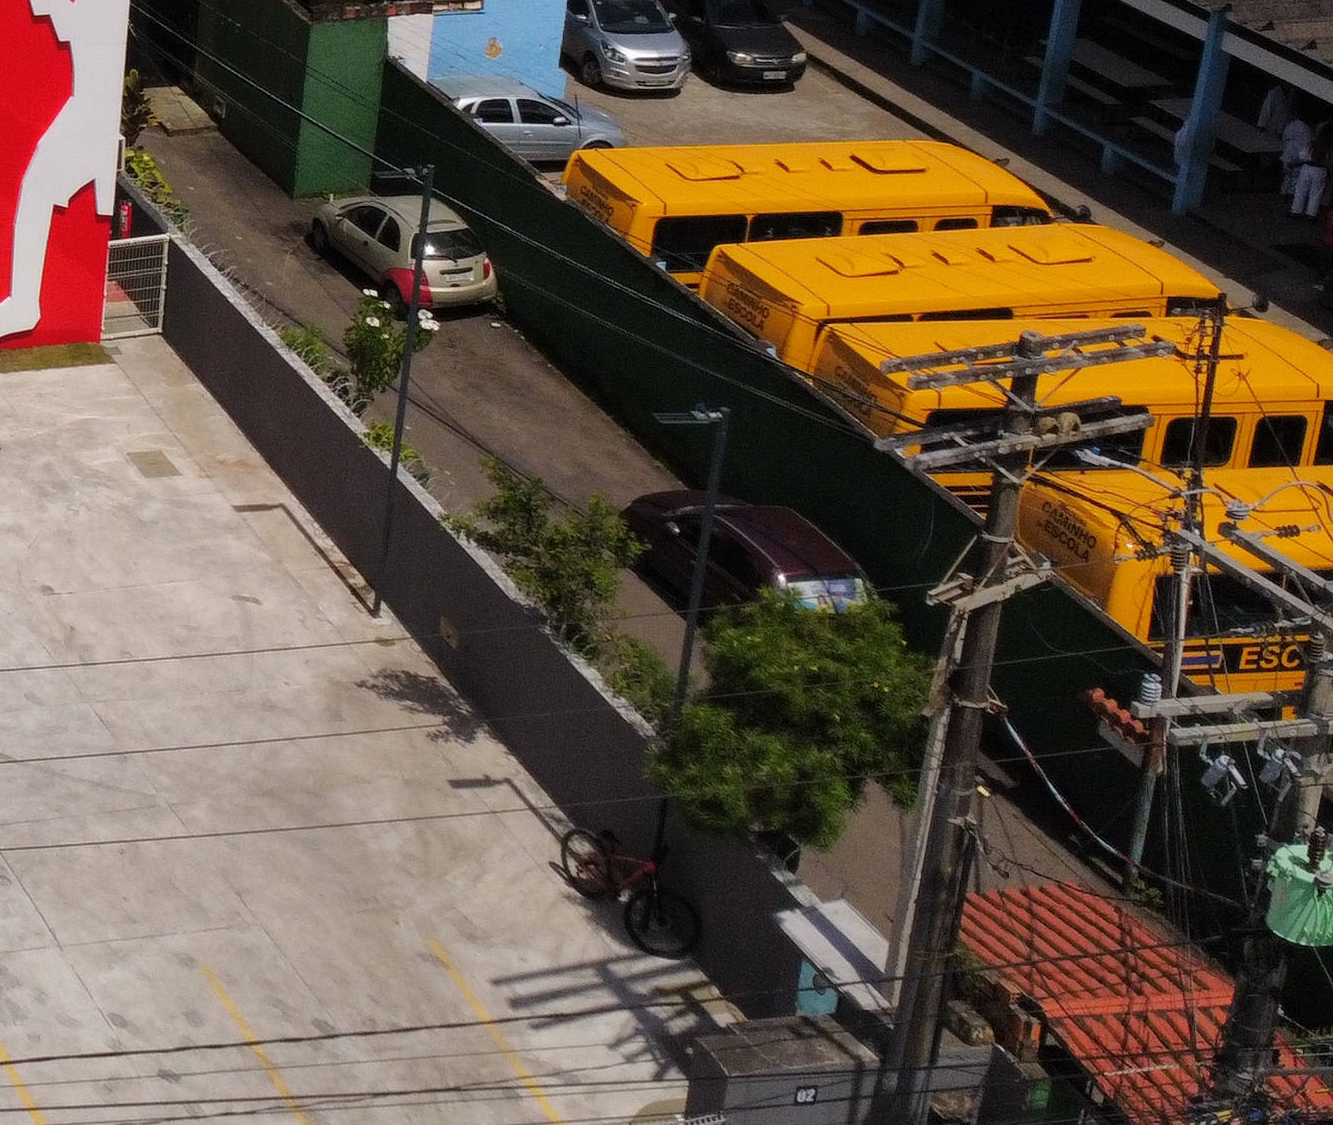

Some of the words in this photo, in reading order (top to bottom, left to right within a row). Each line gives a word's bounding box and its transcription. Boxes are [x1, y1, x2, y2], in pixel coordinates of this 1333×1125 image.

[727, 283, 769, 319] CAMINHO
[728, 298, 764, 331] ESCOLA
[1042, 501, 1096, 549] CAMINHO
[1044, 520, 1089, 563] ESCOLA
